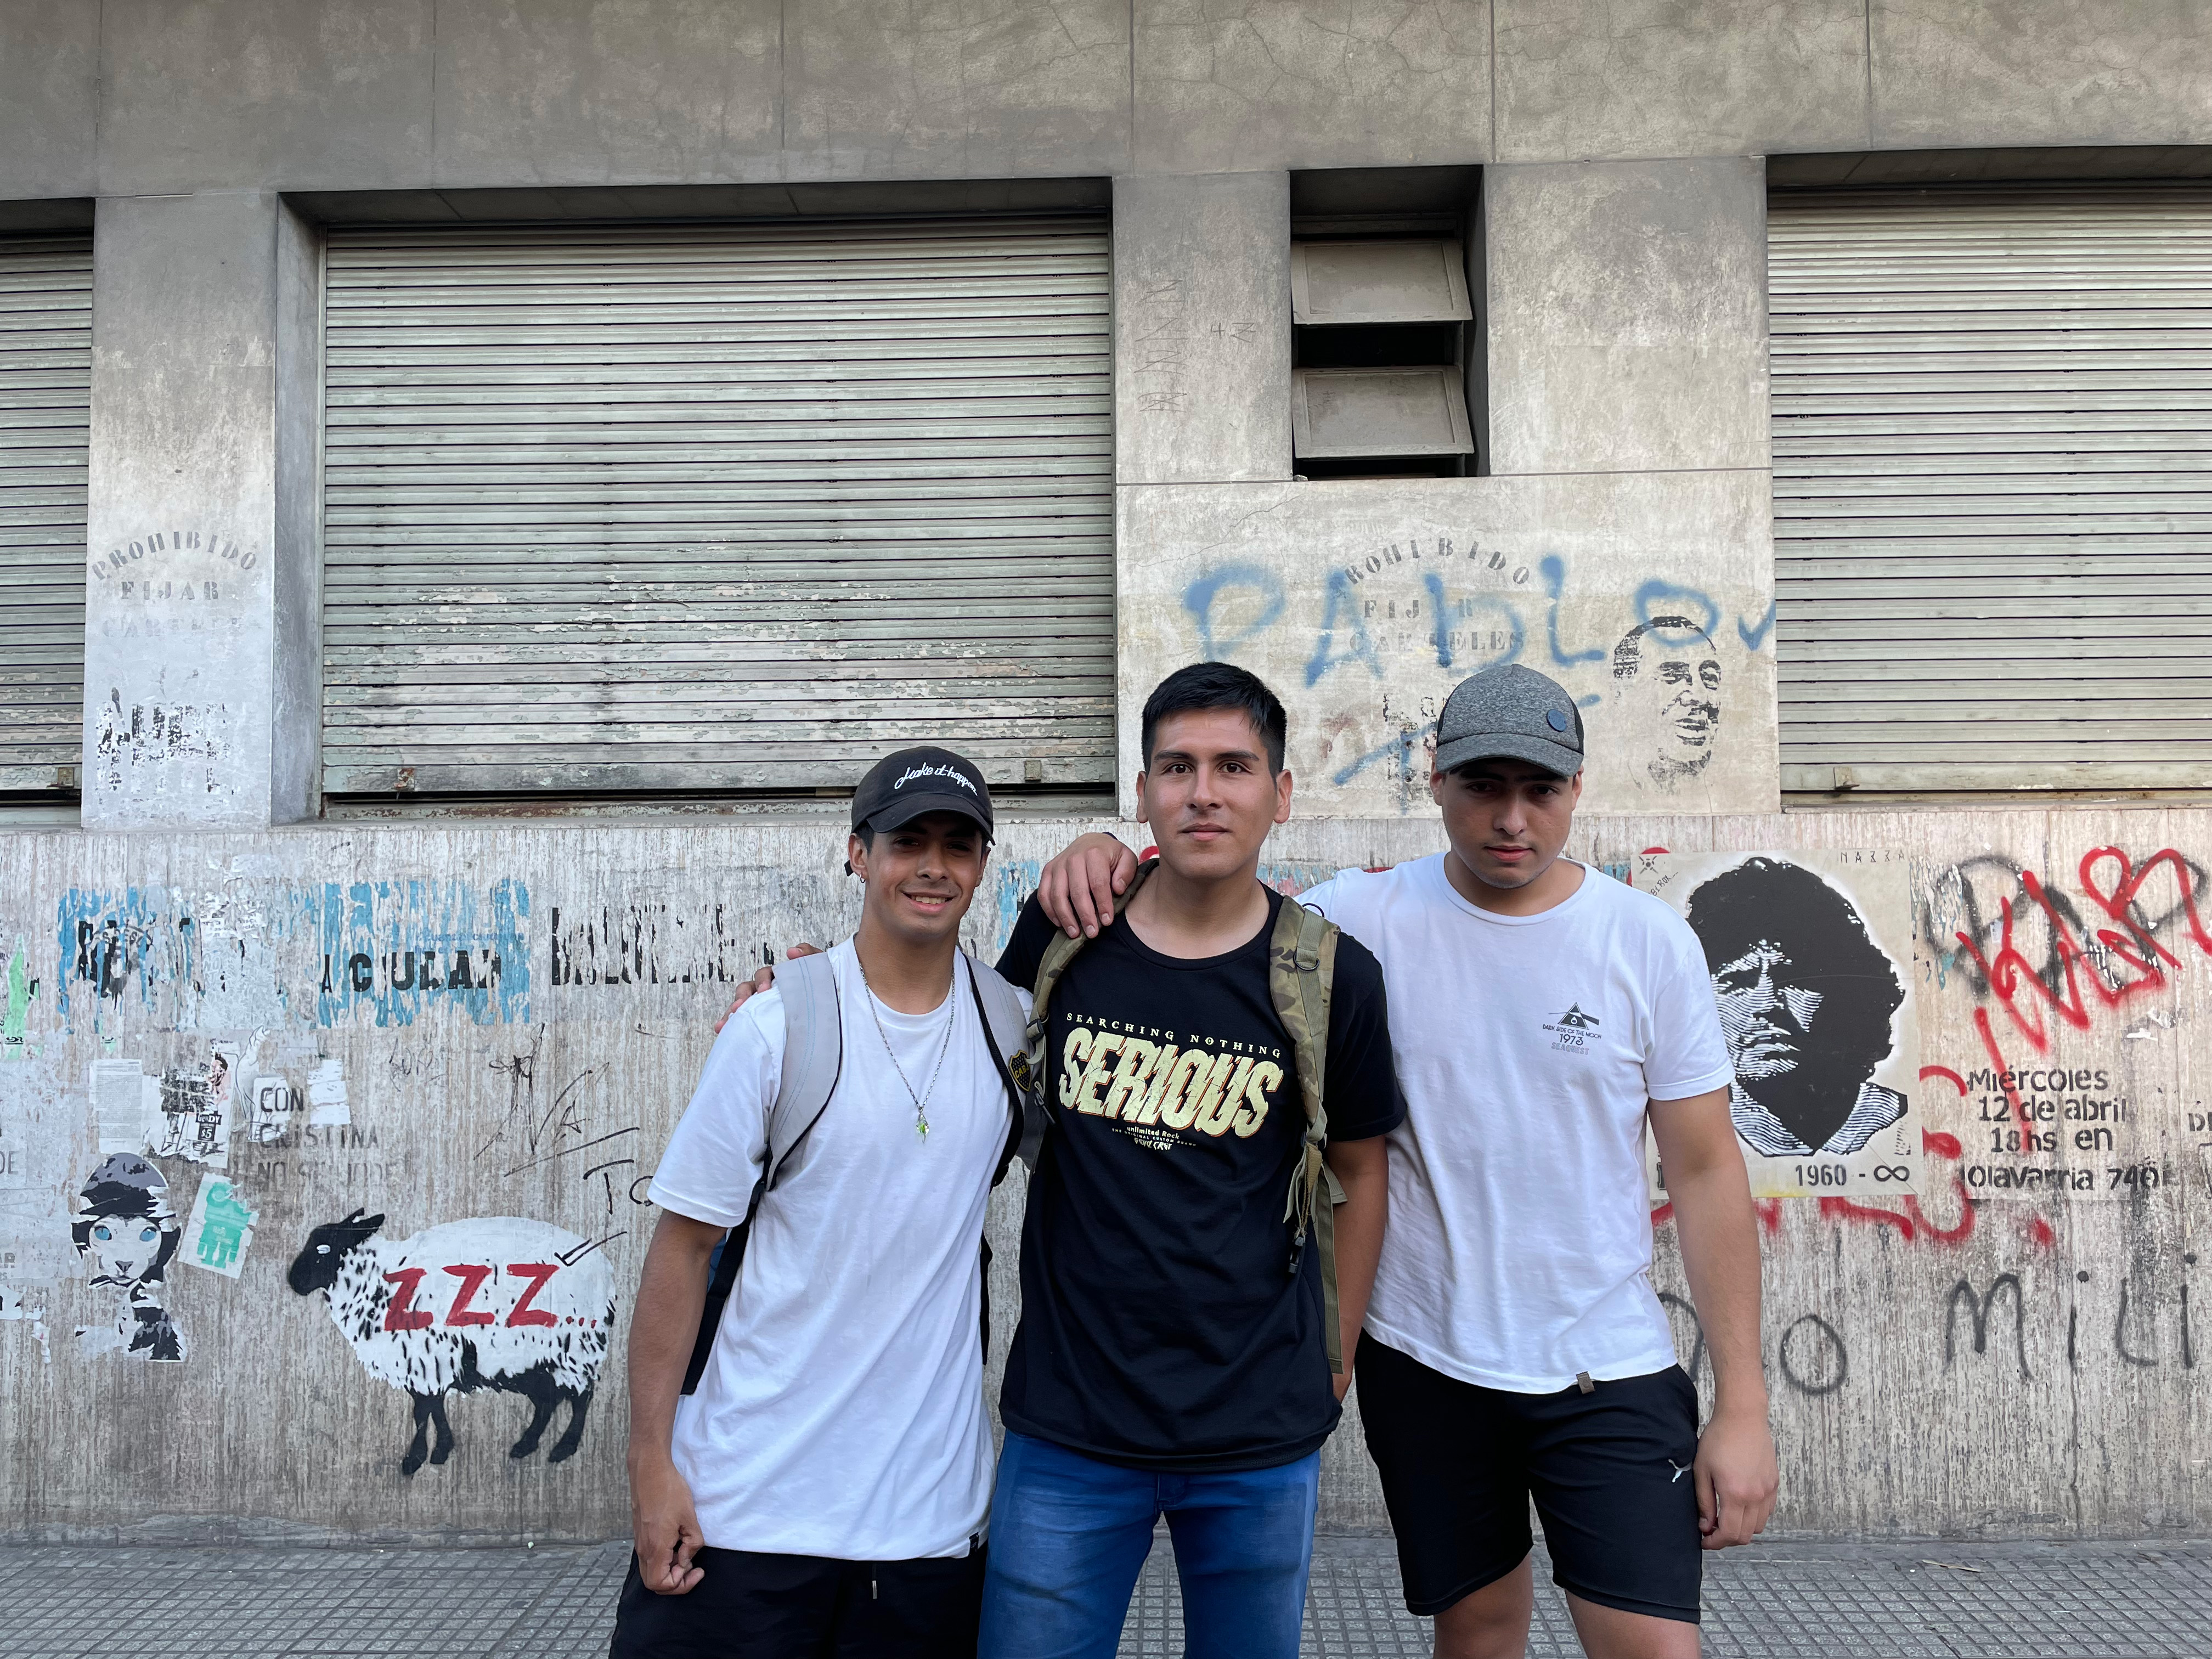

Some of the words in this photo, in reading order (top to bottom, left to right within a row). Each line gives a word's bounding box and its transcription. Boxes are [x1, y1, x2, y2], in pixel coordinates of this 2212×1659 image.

[92, 531, 256, 580] PROHIBIDO
[1336, 538, 1530, 598] ROHIBIDO
[121, 581, 219, 600] FIJAR
[1364, 599, 1473, 618] FIJR
[947, 766, 978, 796] happen
[1066, 1013, 1174, 1041] SEARCHING
[1190, 1034, 1280, 1058] NOTHING
[1560, 1034, 1583, 1046] 1973
[1059, 1027, 1284, 1138] SERIOUS
[1967, 1065, 2108, 1092] Miércoles
[261, 1087, 305, 1112] CON
[1979, 1096, 2010, 1122] 12
[2019, 1094, 2055, 1121] de
[2064, 1094, 2126, 1122] abril
[201, 1128, 212, 1139] $5
[1124, 1131, 1149, 1140] ORIGINAL
[1127, 1126, 1159, 1136] unlimited
[1162, 1131, 1180, 1139] Rock
[2075, 1127, 2113, 1151] en
[1795, 1164, 1847, 1187] 1960
